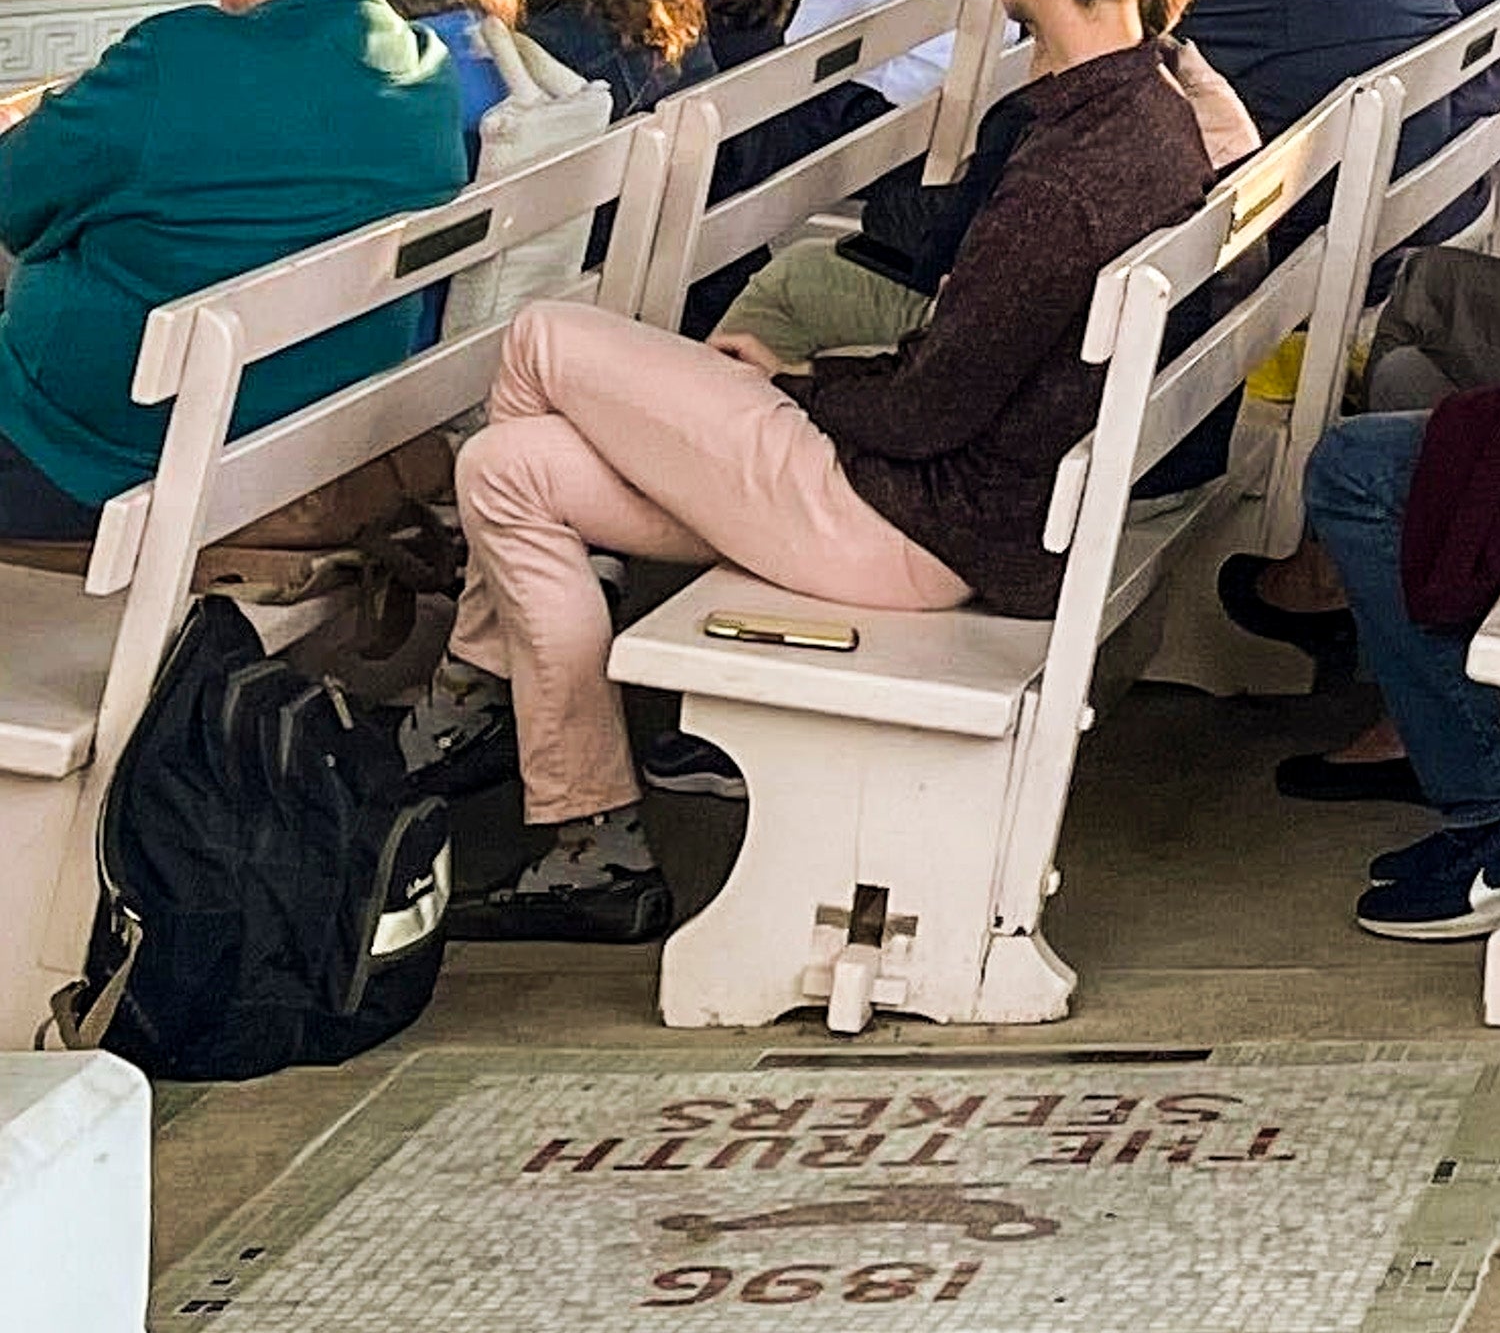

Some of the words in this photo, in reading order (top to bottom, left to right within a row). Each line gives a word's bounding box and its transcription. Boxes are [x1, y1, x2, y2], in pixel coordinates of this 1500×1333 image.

[651, 1094, 1244, 1134] SEEKERS
[521, 1133, 959, 1172] TRUTH
[1029, 1128, 1297, 1167] THE
[638, 1261, 983, 1307] 1896
